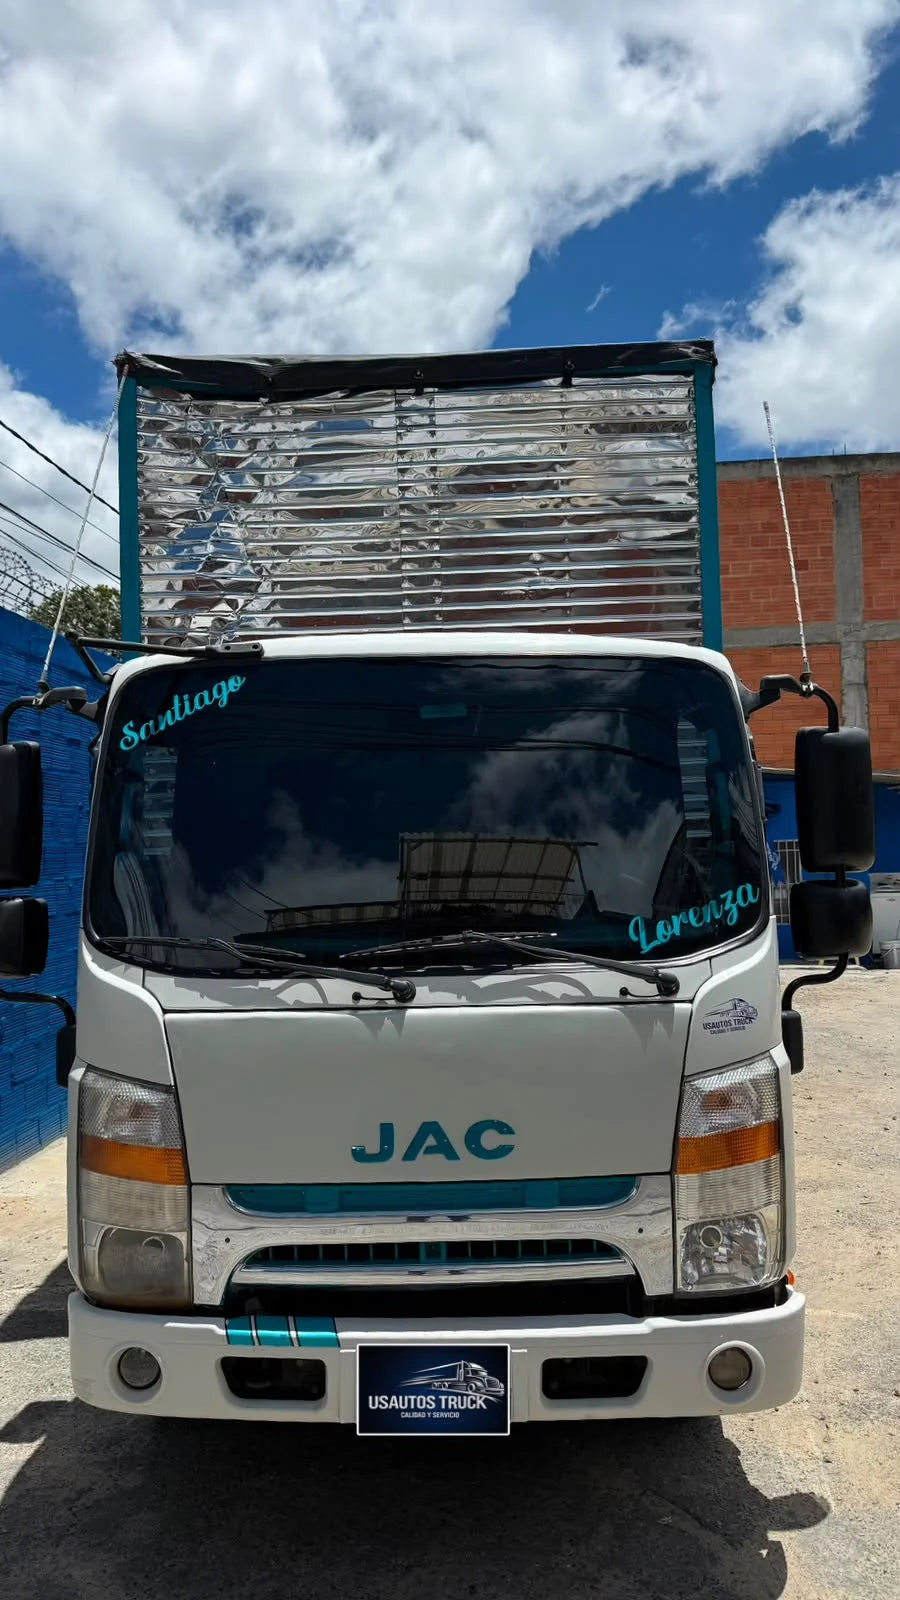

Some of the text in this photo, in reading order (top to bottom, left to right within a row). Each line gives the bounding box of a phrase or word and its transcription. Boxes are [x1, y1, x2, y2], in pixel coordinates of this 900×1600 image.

[119, 674, 247, 750] Santiago
[628, 882, 760, 954] Lorenza
[702, 1019, 732, 1030] USAUTOS
[351, 1119, 516, 1163] JAC
